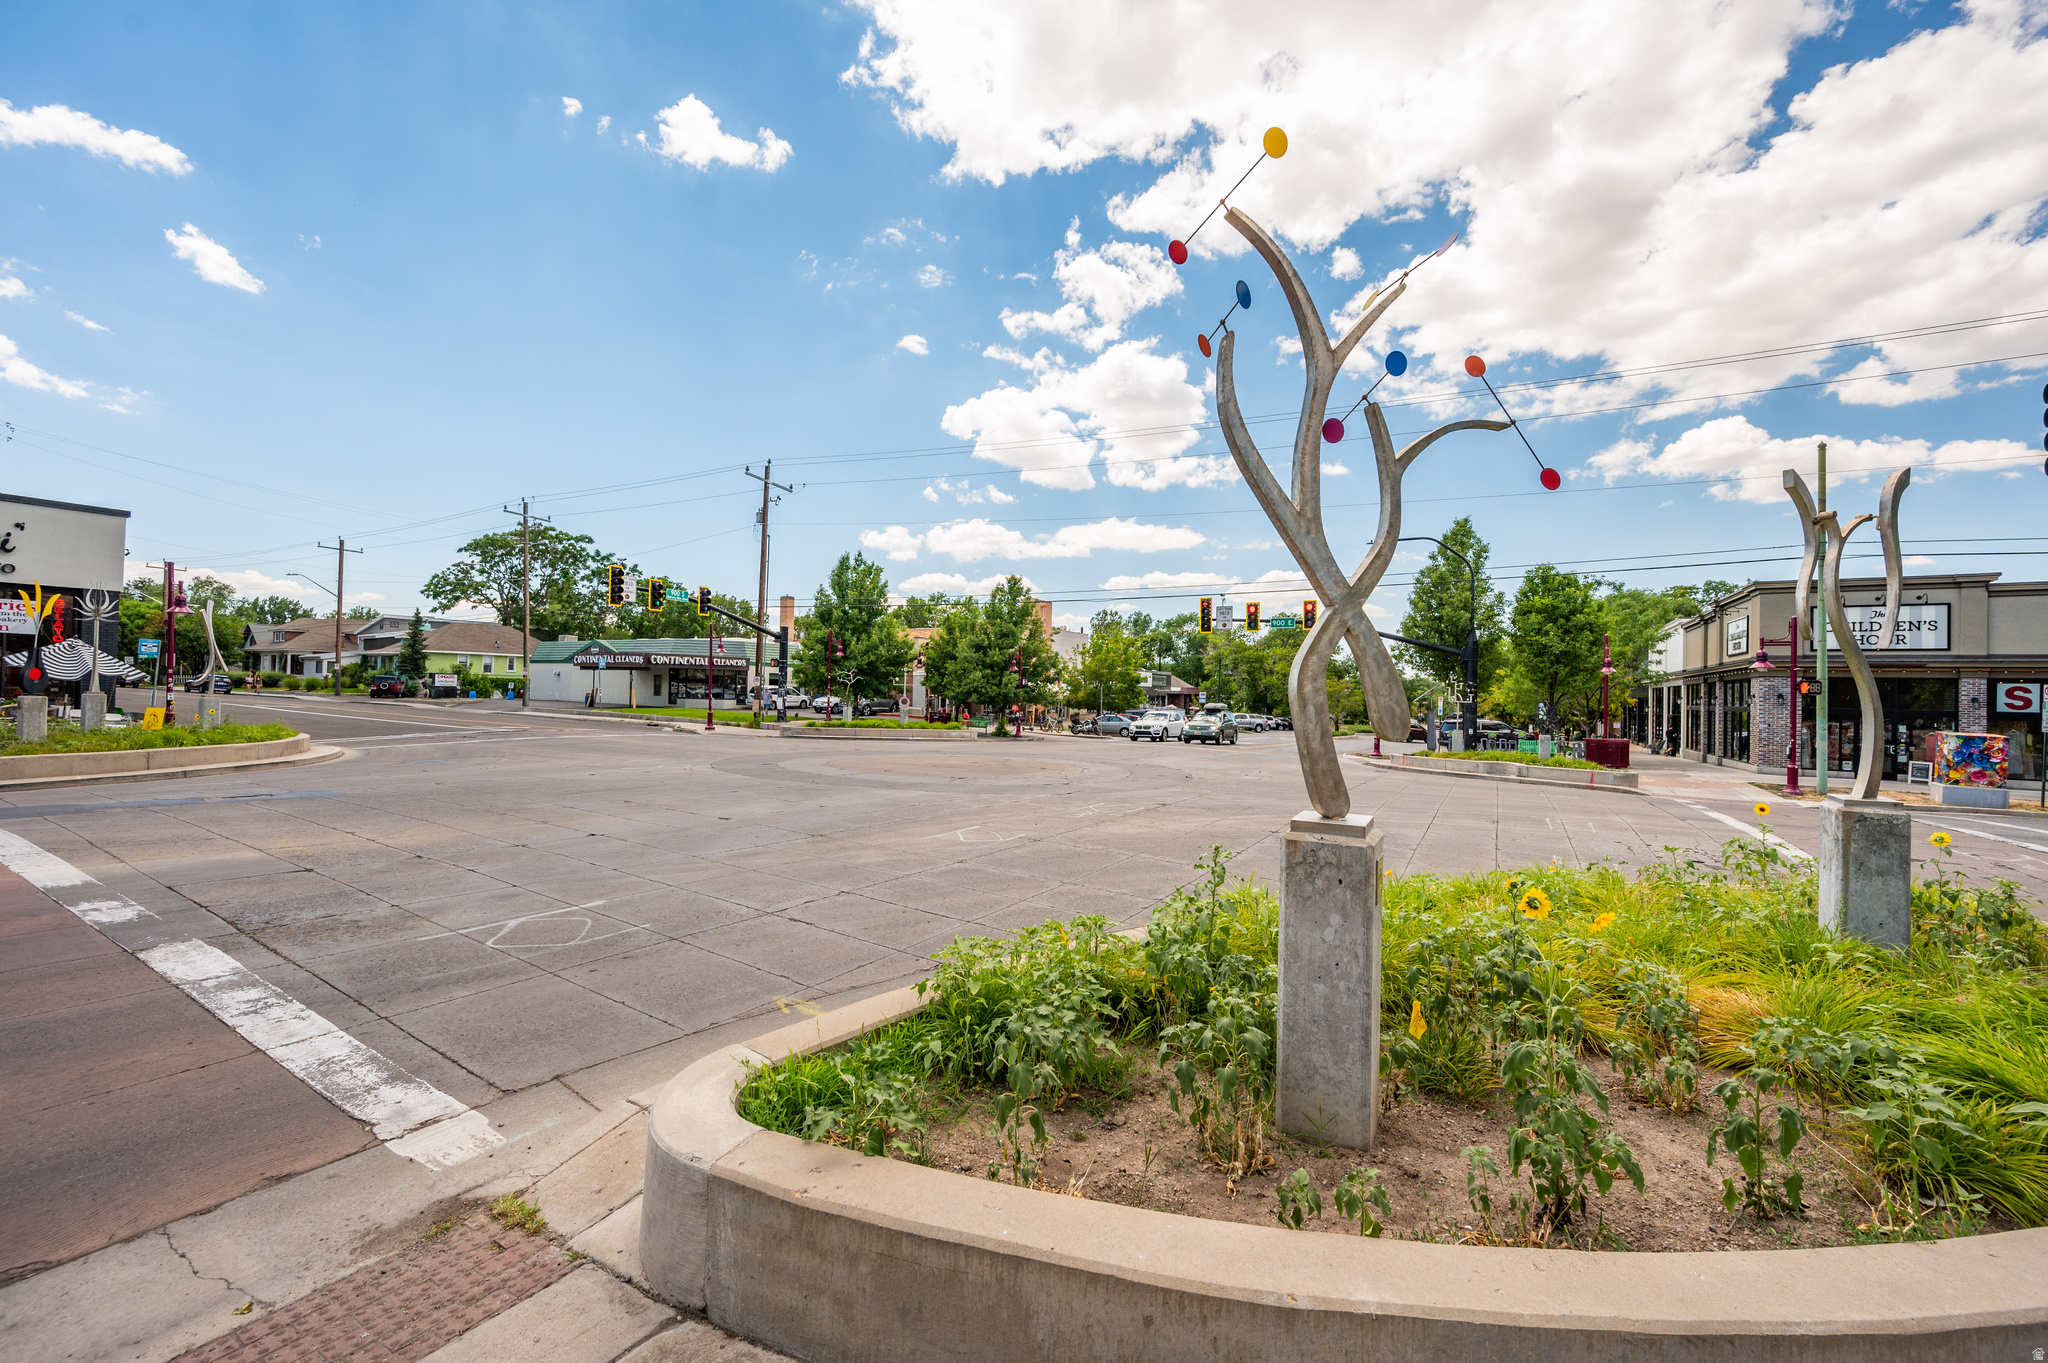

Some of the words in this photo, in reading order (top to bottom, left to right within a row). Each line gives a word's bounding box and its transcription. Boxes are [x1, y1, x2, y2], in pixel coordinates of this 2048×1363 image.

[52, 598, 65, 643] GELATO
[1855, 634, 1907, 646] HOR
[615, 655, 644, 664] CLEANERS
[651, 655, 709, 666] CONTINENTAL
[713, 658, 747, 667] CLEANERS
[2003, 685, 2034, 711] S
